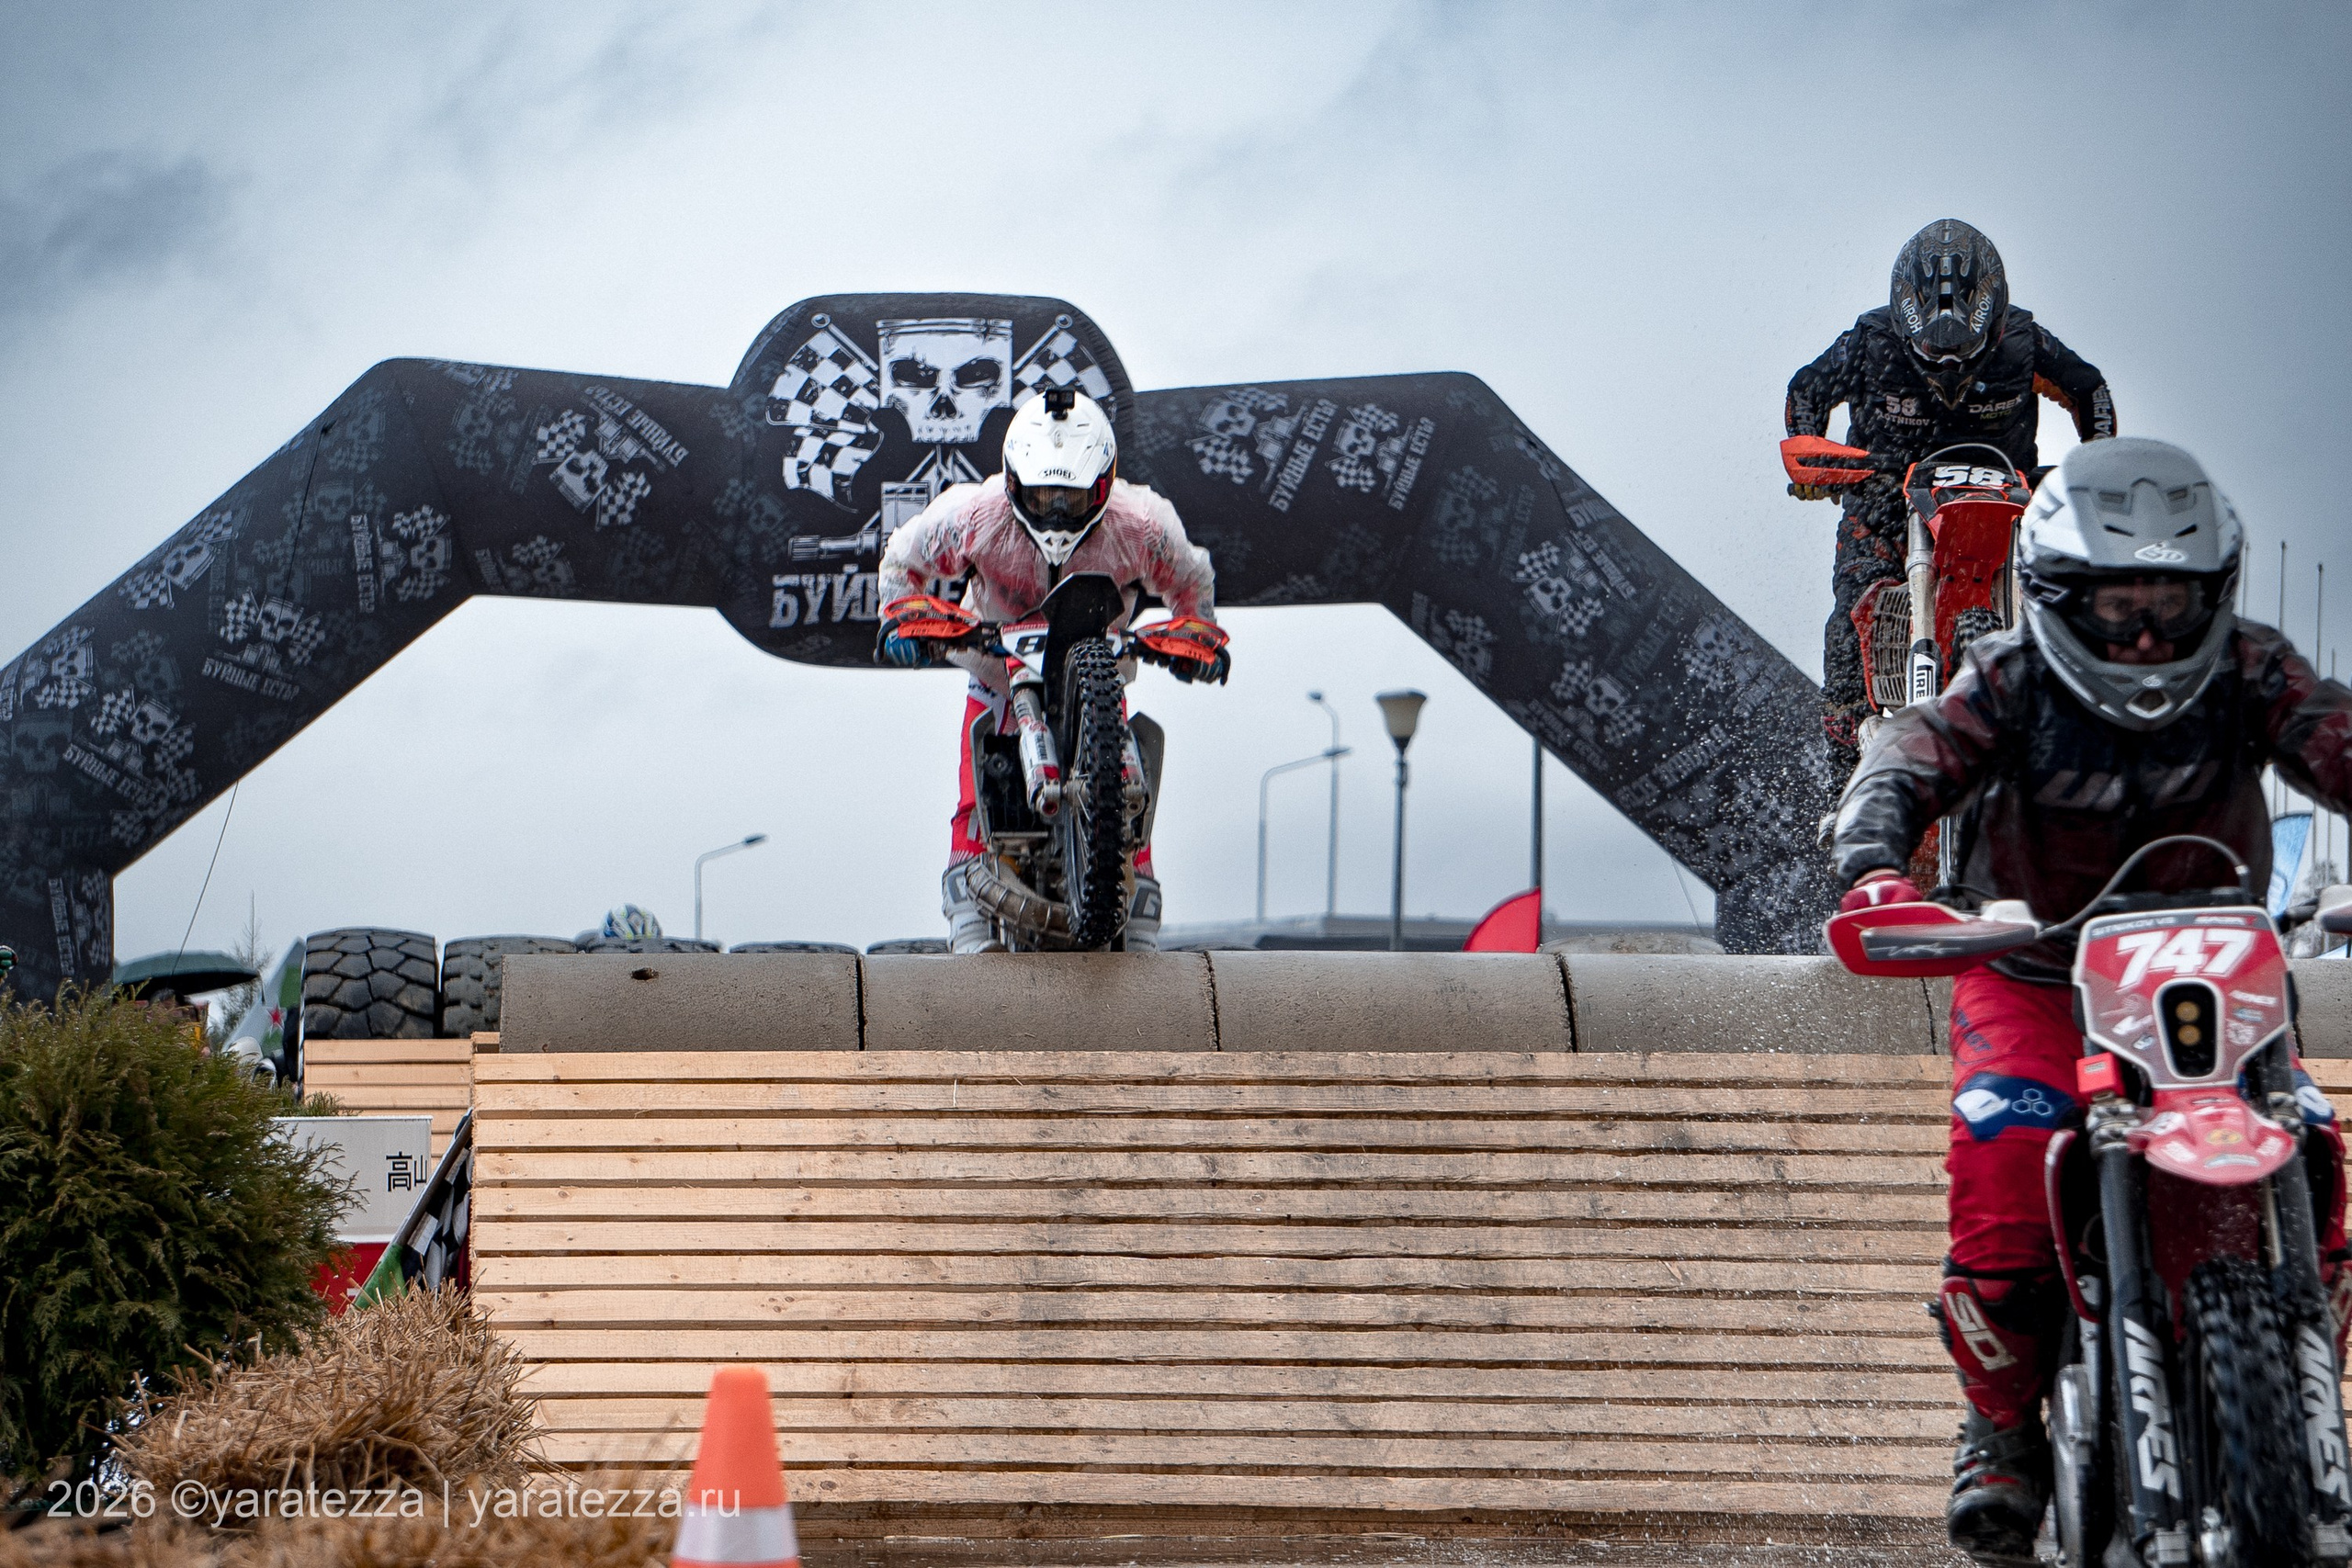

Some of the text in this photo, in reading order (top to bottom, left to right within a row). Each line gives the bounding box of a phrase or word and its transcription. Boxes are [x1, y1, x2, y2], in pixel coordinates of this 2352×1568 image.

[1901, 297, 1924, 333] AIROH
[1970, 292, 1992, 333] AIROH
[1044, 468, 1072, 479] SHOEI
[1268, 438, 1317, 513] БУЙНЫЕ
[1932, 465, 2006, 490] 58
[201, 656, 261, 693] БУЙНЫЕ
[2115, 928, 2256, 992] 747
